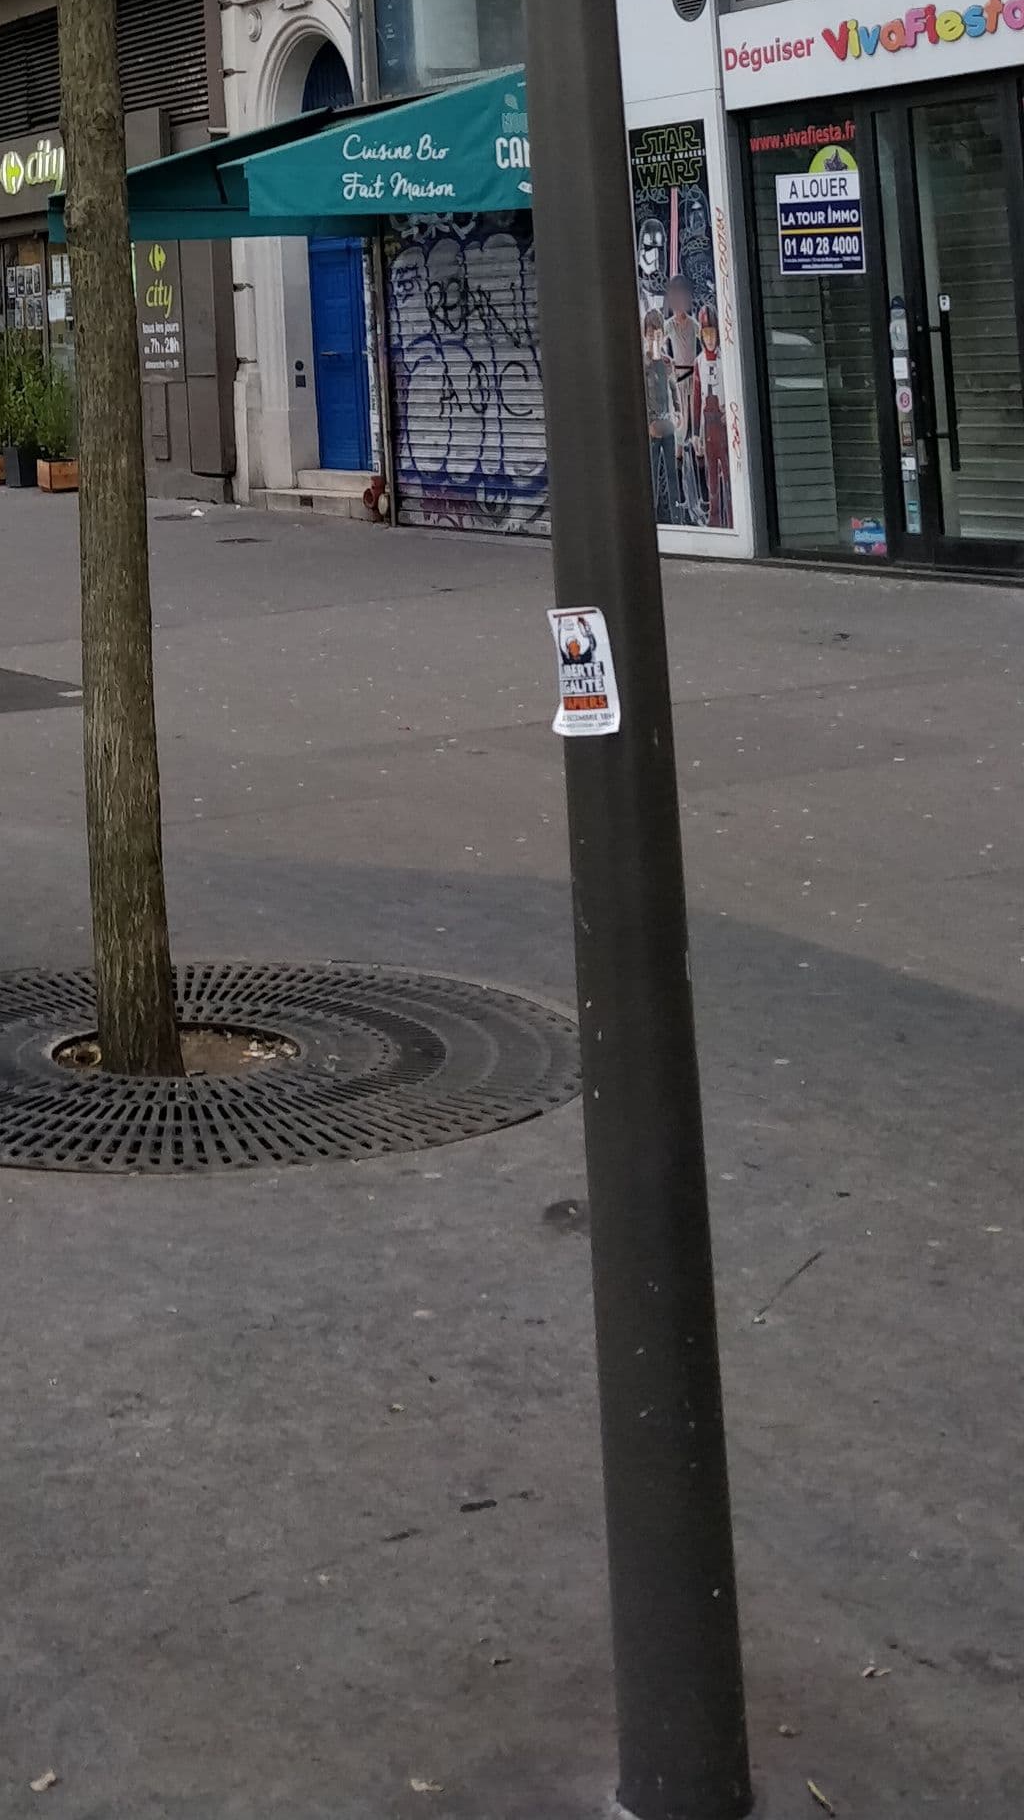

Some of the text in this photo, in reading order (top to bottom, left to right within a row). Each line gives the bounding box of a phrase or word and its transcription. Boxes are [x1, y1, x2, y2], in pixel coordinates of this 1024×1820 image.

[724, 35, 815, 72] Déguiser
[342, 134, 450, 160] Cuisine Bio
[635, 125, 701, 157] STAR
[750, 120, 856, 153] www.vivafiesta.fr
[637, 157, 703, 189] WARS
[648, 154, 670, 163] FORCE
[342, 171, 456, 201] Fait Maison
[789, 178, 848, 199] A LOUER
[781, 205, 858, 225] LA TOUR IMMO
[785, 236, 859, 255] 01 40 28 4000
[146, 279, 172, 319] city
